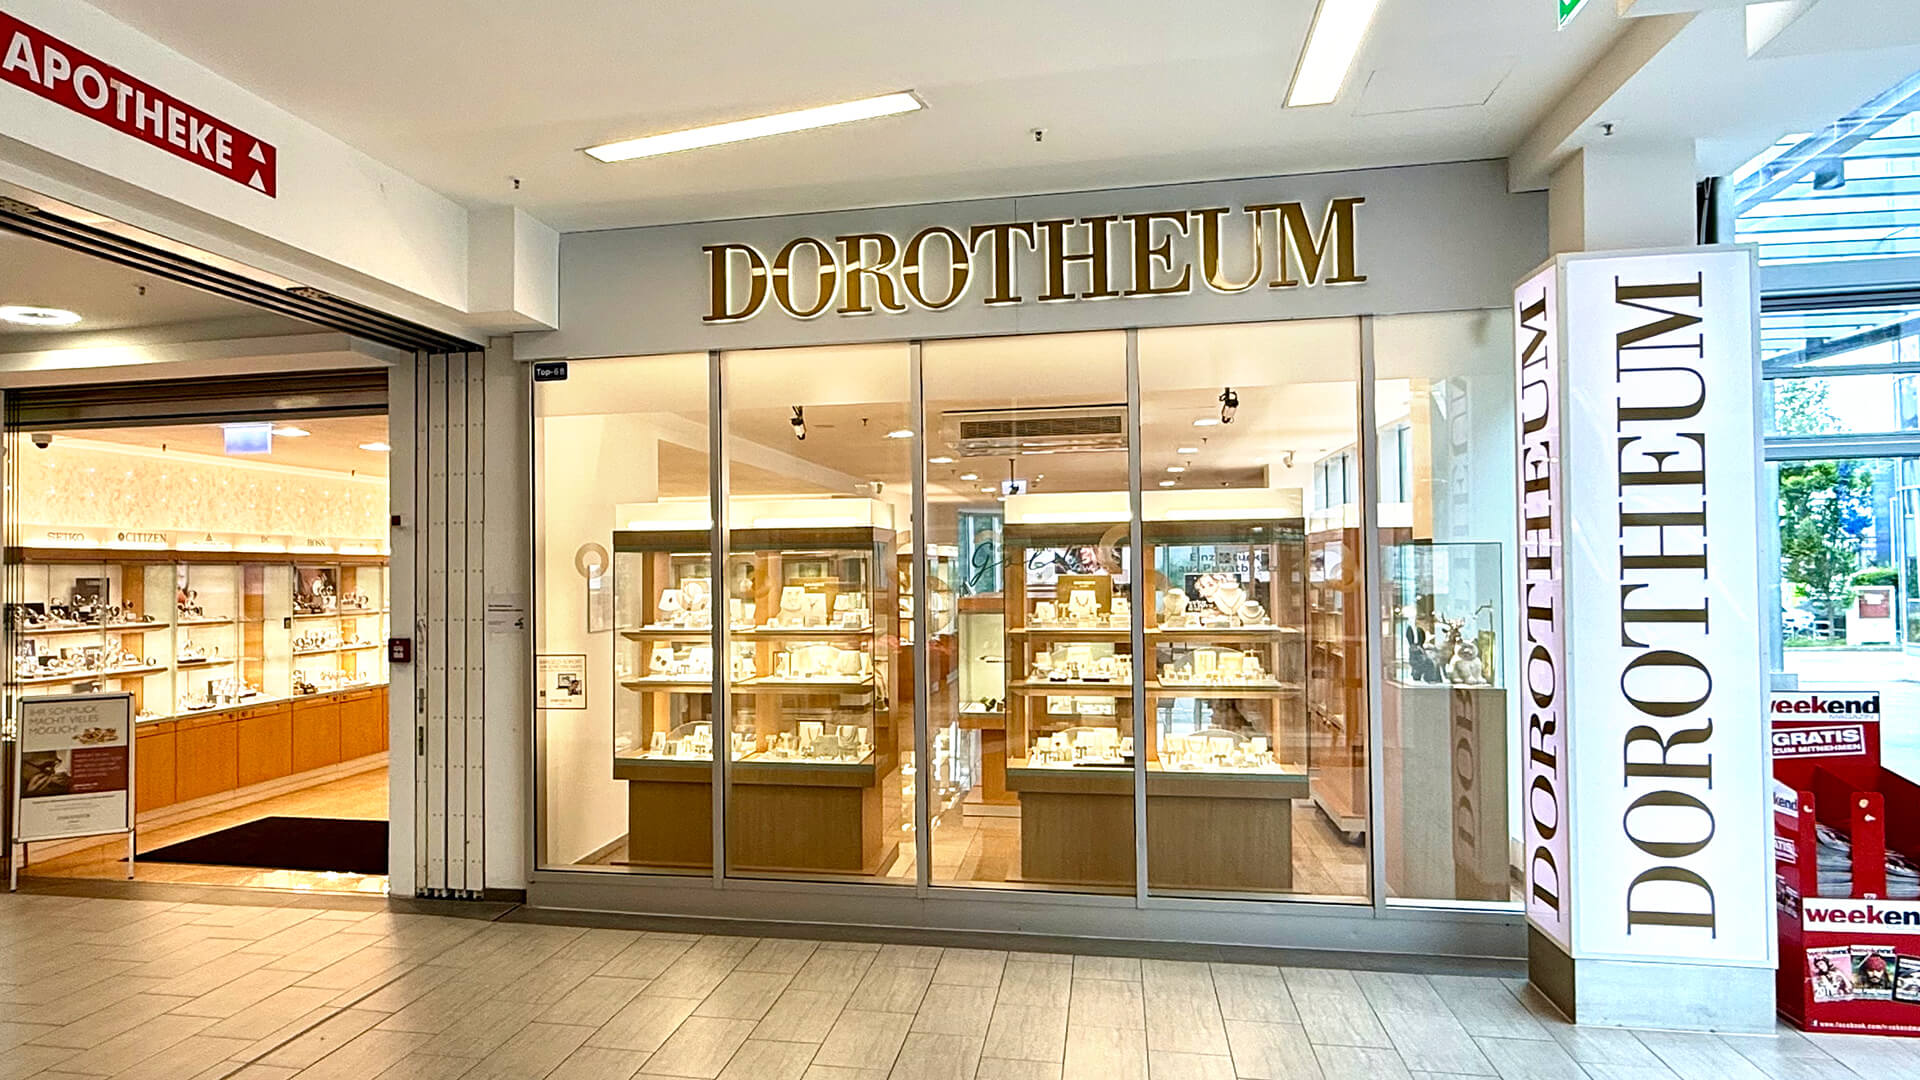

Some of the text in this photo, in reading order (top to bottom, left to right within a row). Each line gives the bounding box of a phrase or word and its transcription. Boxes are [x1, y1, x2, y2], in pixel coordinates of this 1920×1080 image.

[2, 31, 234, 170] APOTHEKE
[702, 196, 1368, 322] DOROTHEUM
[126, 531, 167, 544] CITIZEN
[1519, 286, 1561, 923] DOROTHEUM
[1614, 270, 1717, 940] DOROTHEUM
[1772, 729, 1860, 746] GRATIS
[1773, 791, 1798, 811] kend
[1805, 905, 1920, 925] weeken
